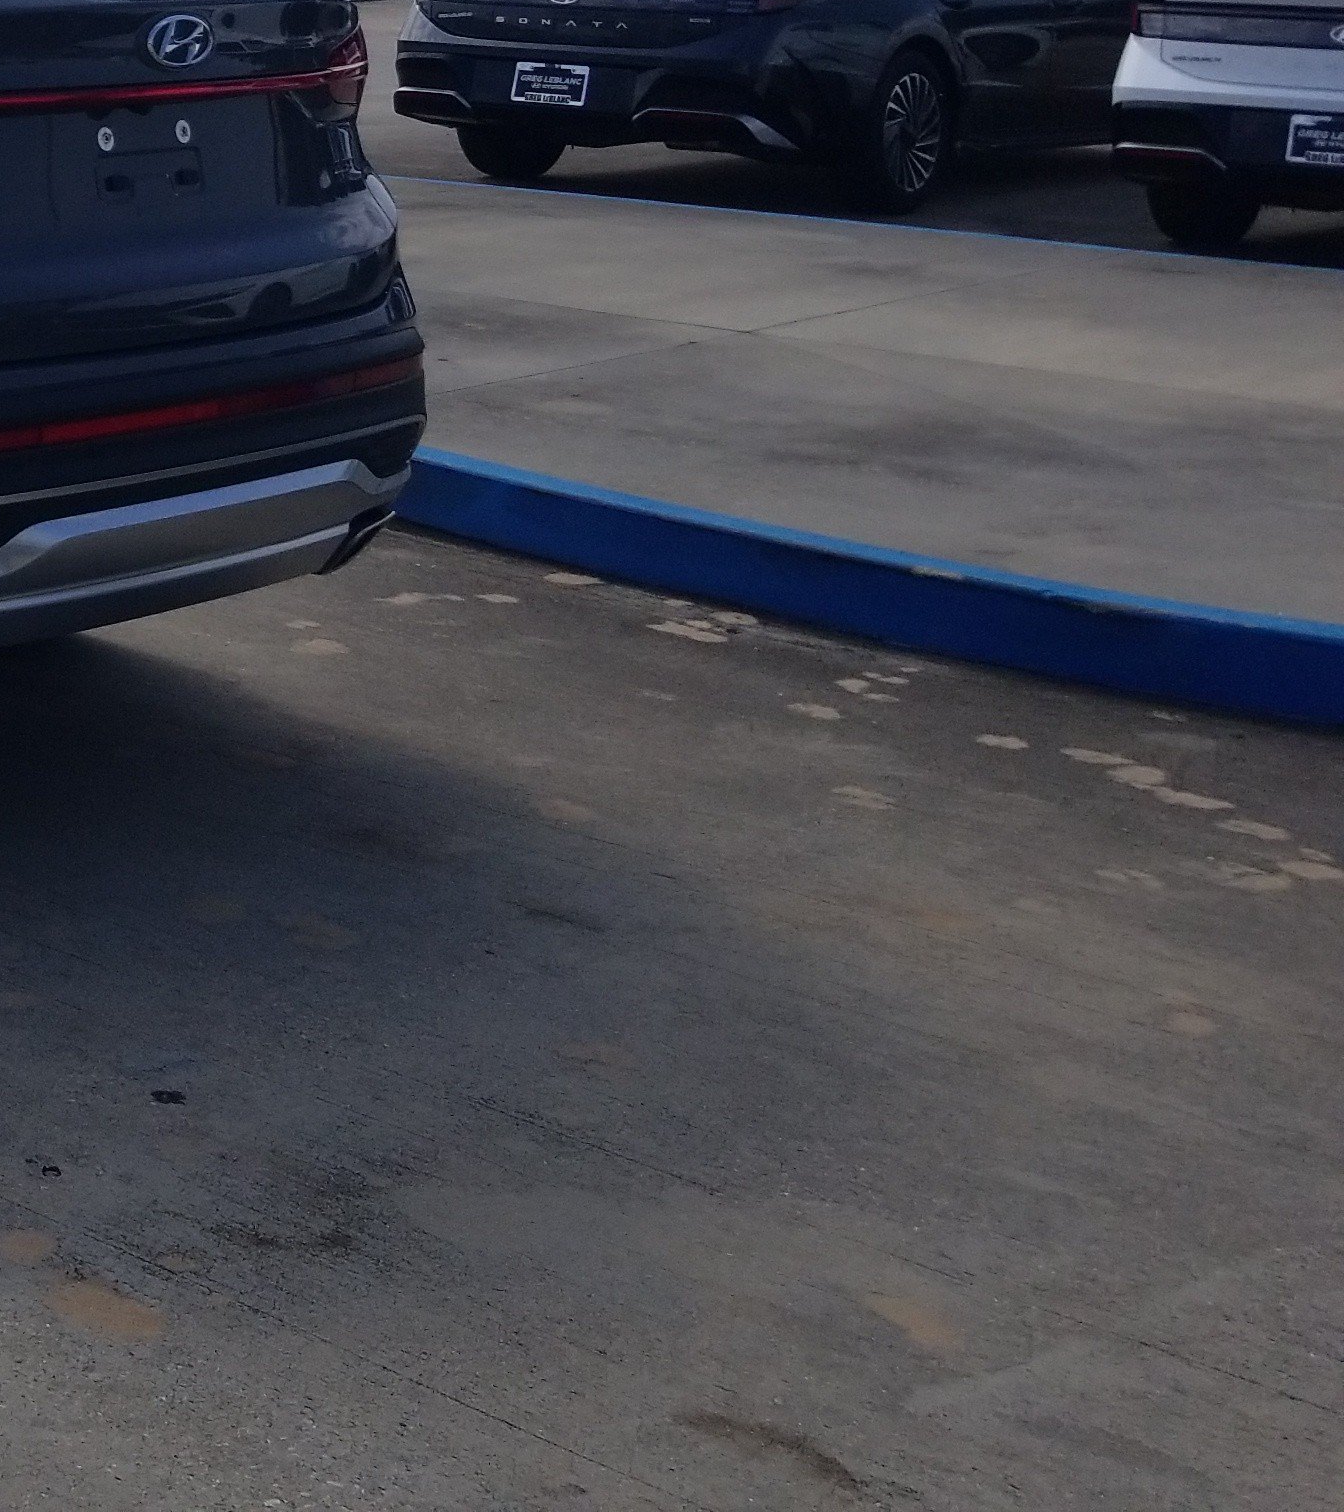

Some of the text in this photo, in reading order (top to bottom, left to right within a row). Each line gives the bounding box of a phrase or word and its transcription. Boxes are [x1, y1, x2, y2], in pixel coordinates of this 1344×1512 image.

[495, 15, 628, 30] SONATA
[520, 74, 583, 85] GREG LEBLANC
